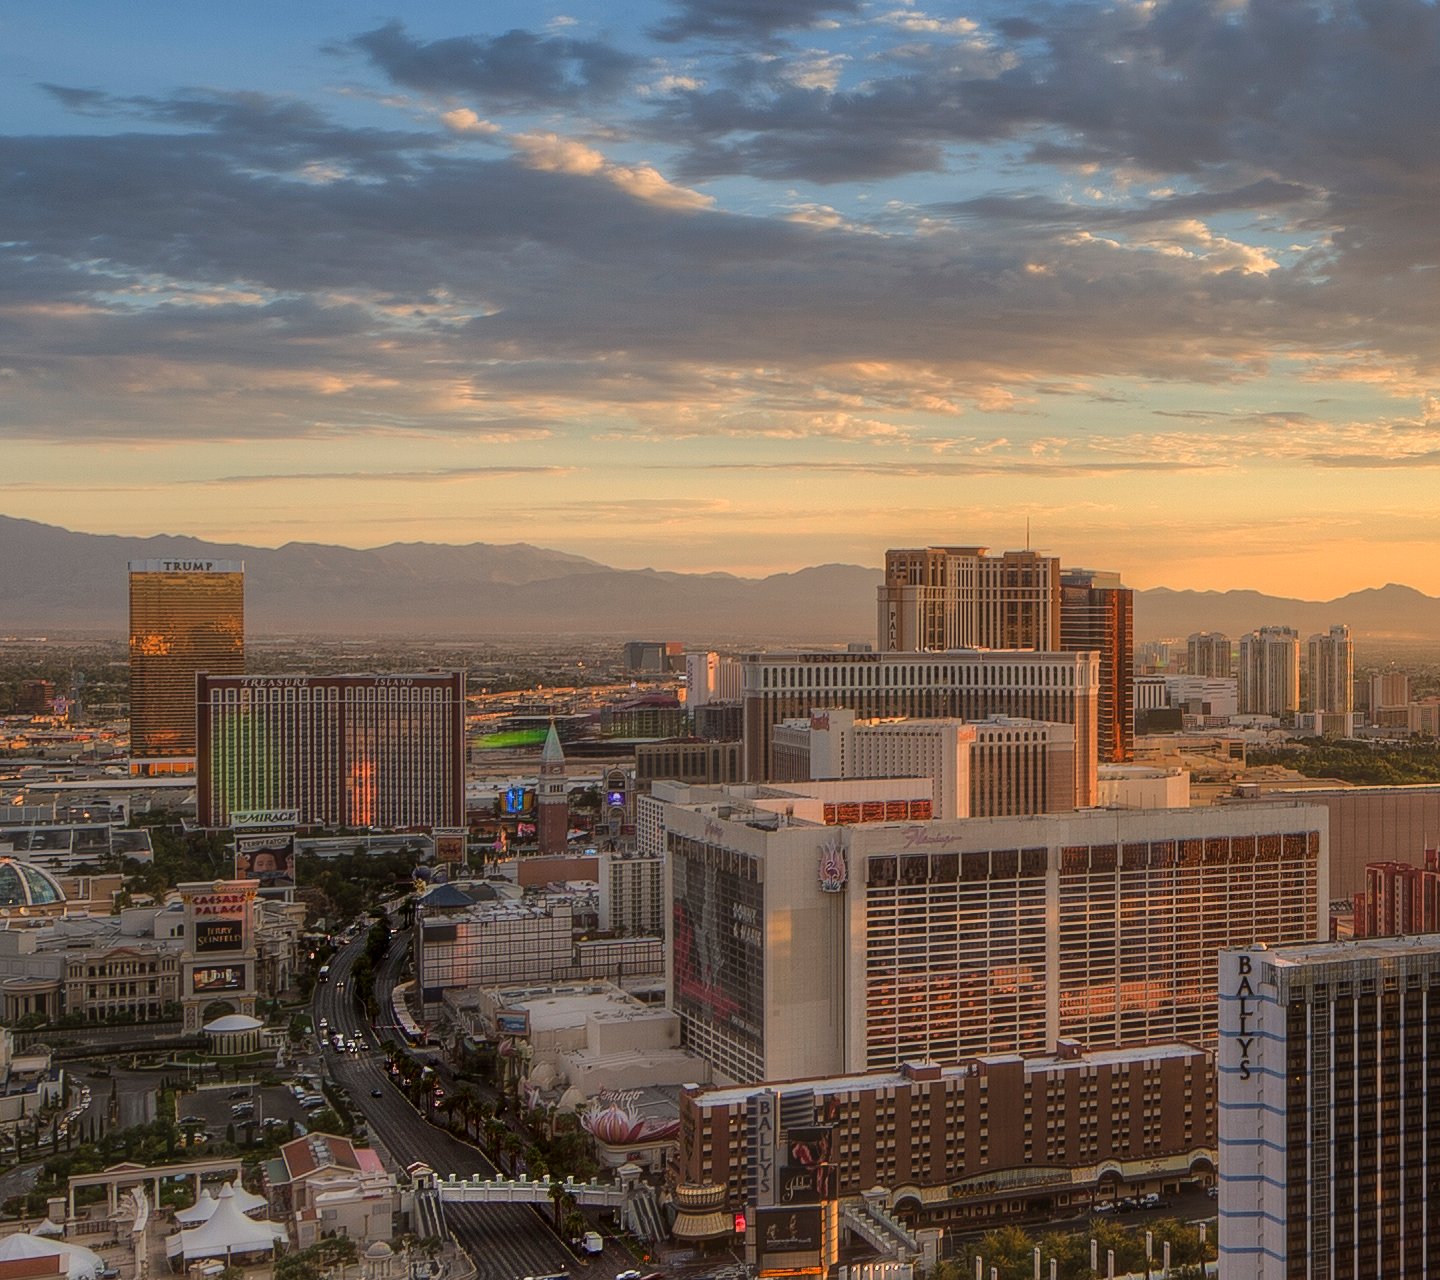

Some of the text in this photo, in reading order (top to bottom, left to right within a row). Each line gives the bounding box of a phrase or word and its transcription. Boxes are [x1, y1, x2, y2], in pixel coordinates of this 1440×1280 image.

[163, 561, 213, 571] TRUMP
[802, 654, 877, 663] VENETIAN
[240, 678, 414, 688] TREASURE ISLAND
[241, 812, 296, 824] MIRAGE
[192, 893, 246, 906] CAESARS
[195, 905, 243, 916] PALACE
[207, 926, 233, 936] JERRY
[197, 934, 242, 946] SEINFELD
